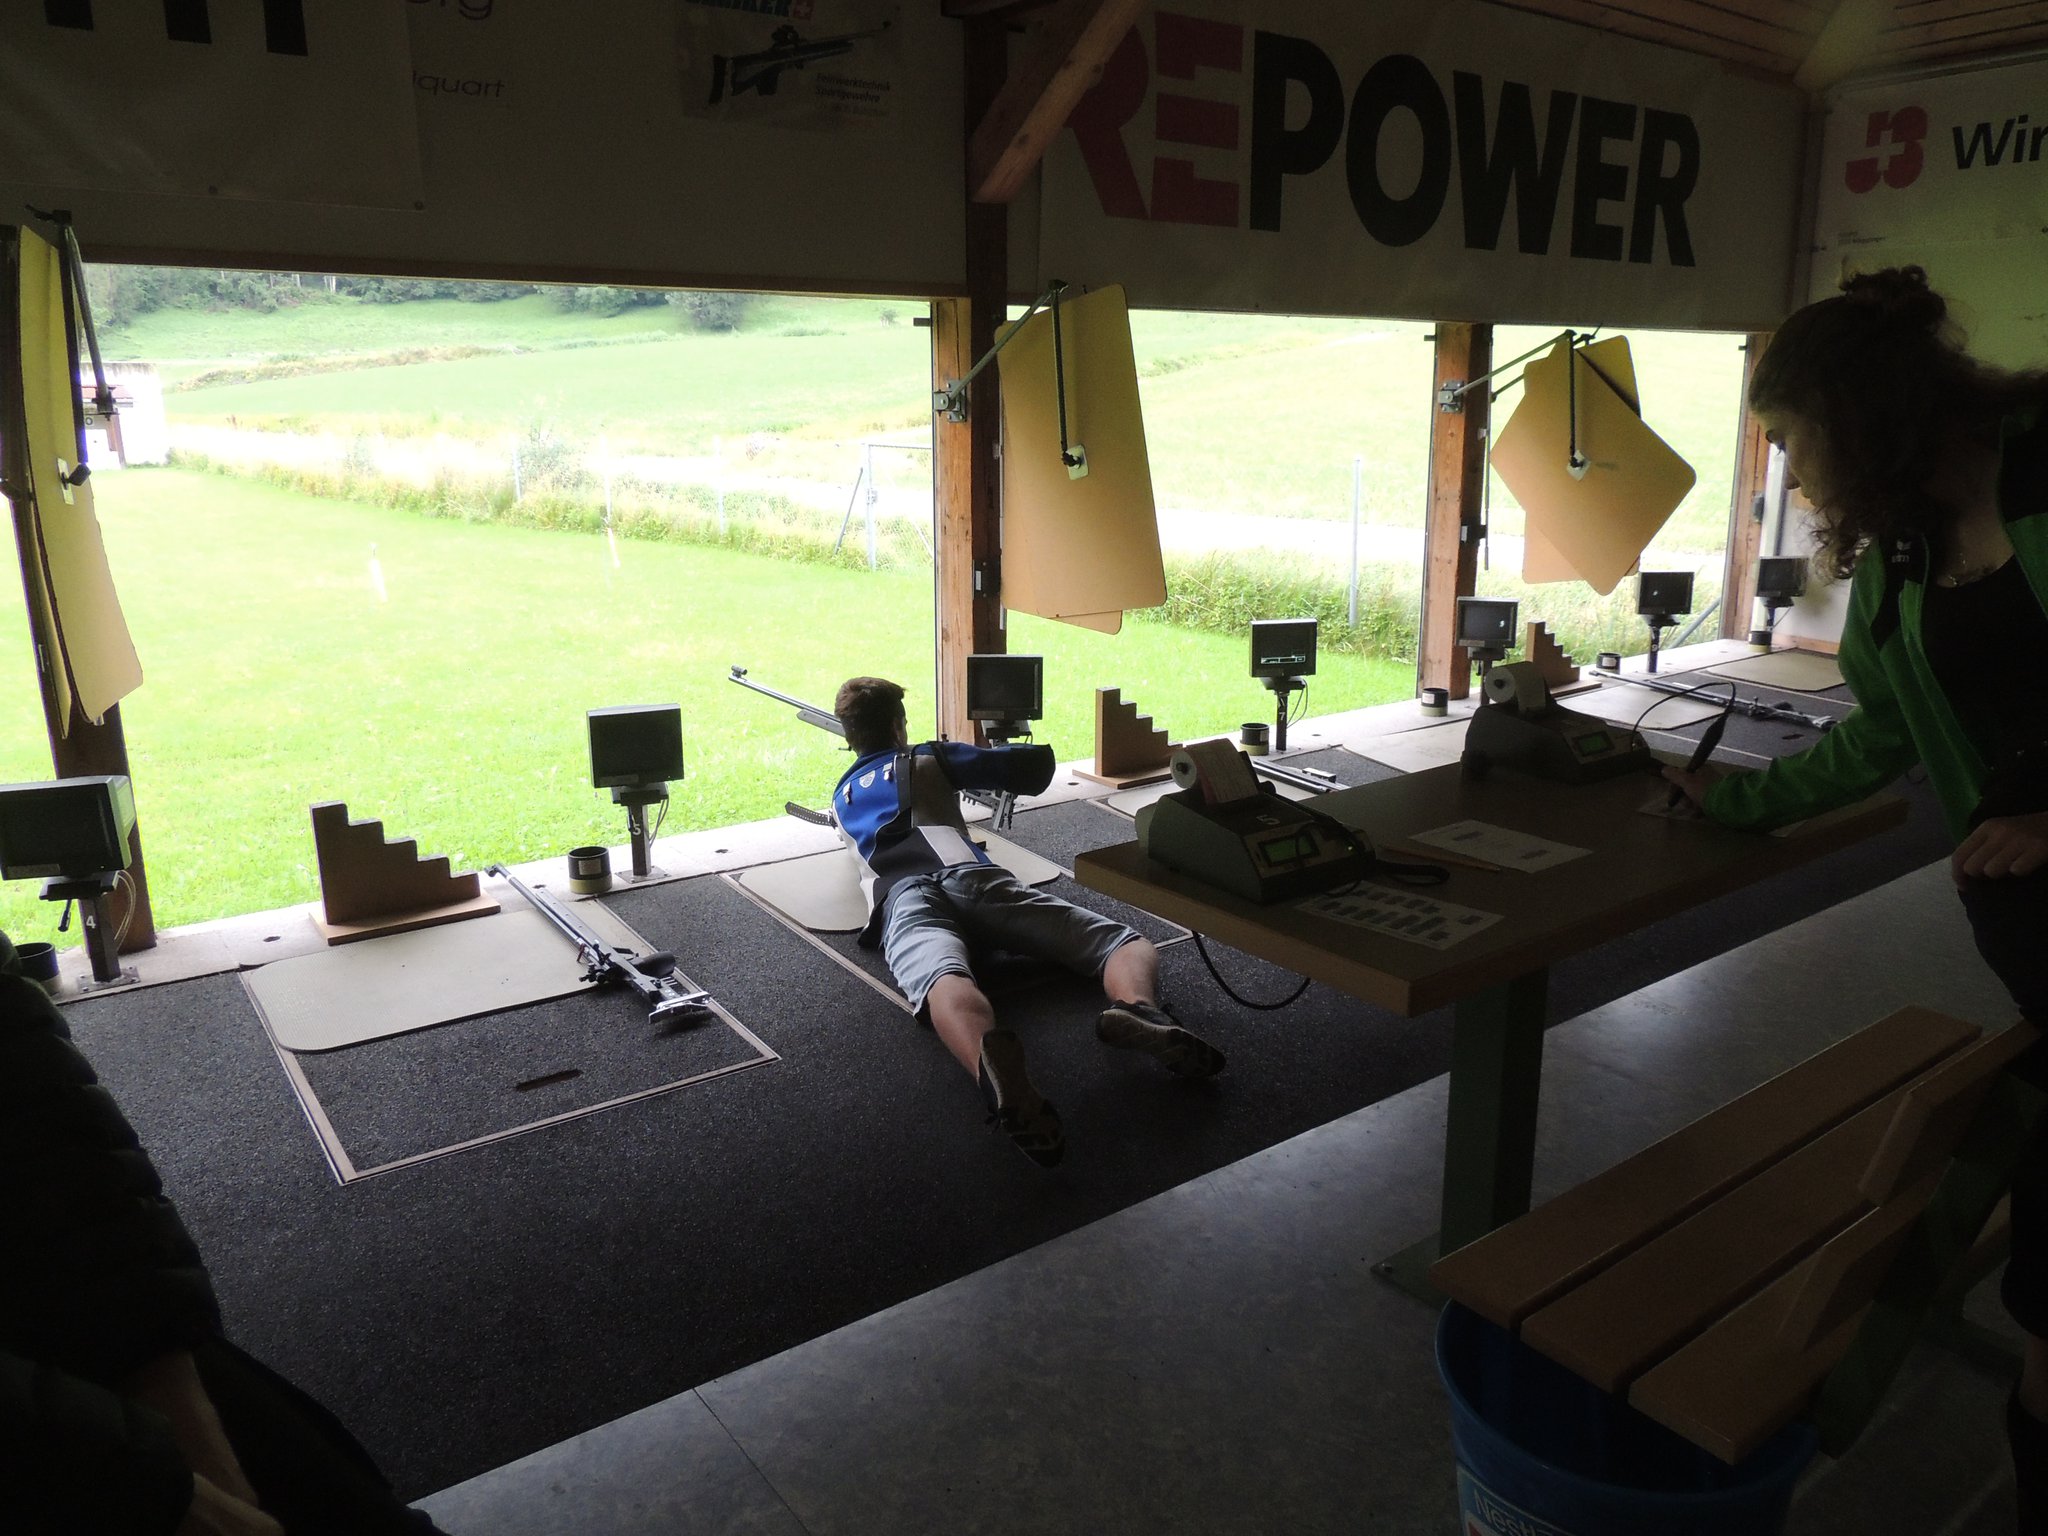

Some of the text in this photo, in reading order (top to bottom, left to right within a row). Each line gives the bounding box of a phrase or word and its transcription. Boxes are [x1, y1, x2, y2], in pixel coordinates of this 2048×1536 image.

[1063, 11, 1701, 268] REPOWER
[1279, 711, 1286, 721] 7
[1256, 814, 1281, 826] 5
[632, 823, 642, 836] 5
[86, 915, 97, 929] 4
[1474, 1488, 1552, 1536] Nest
